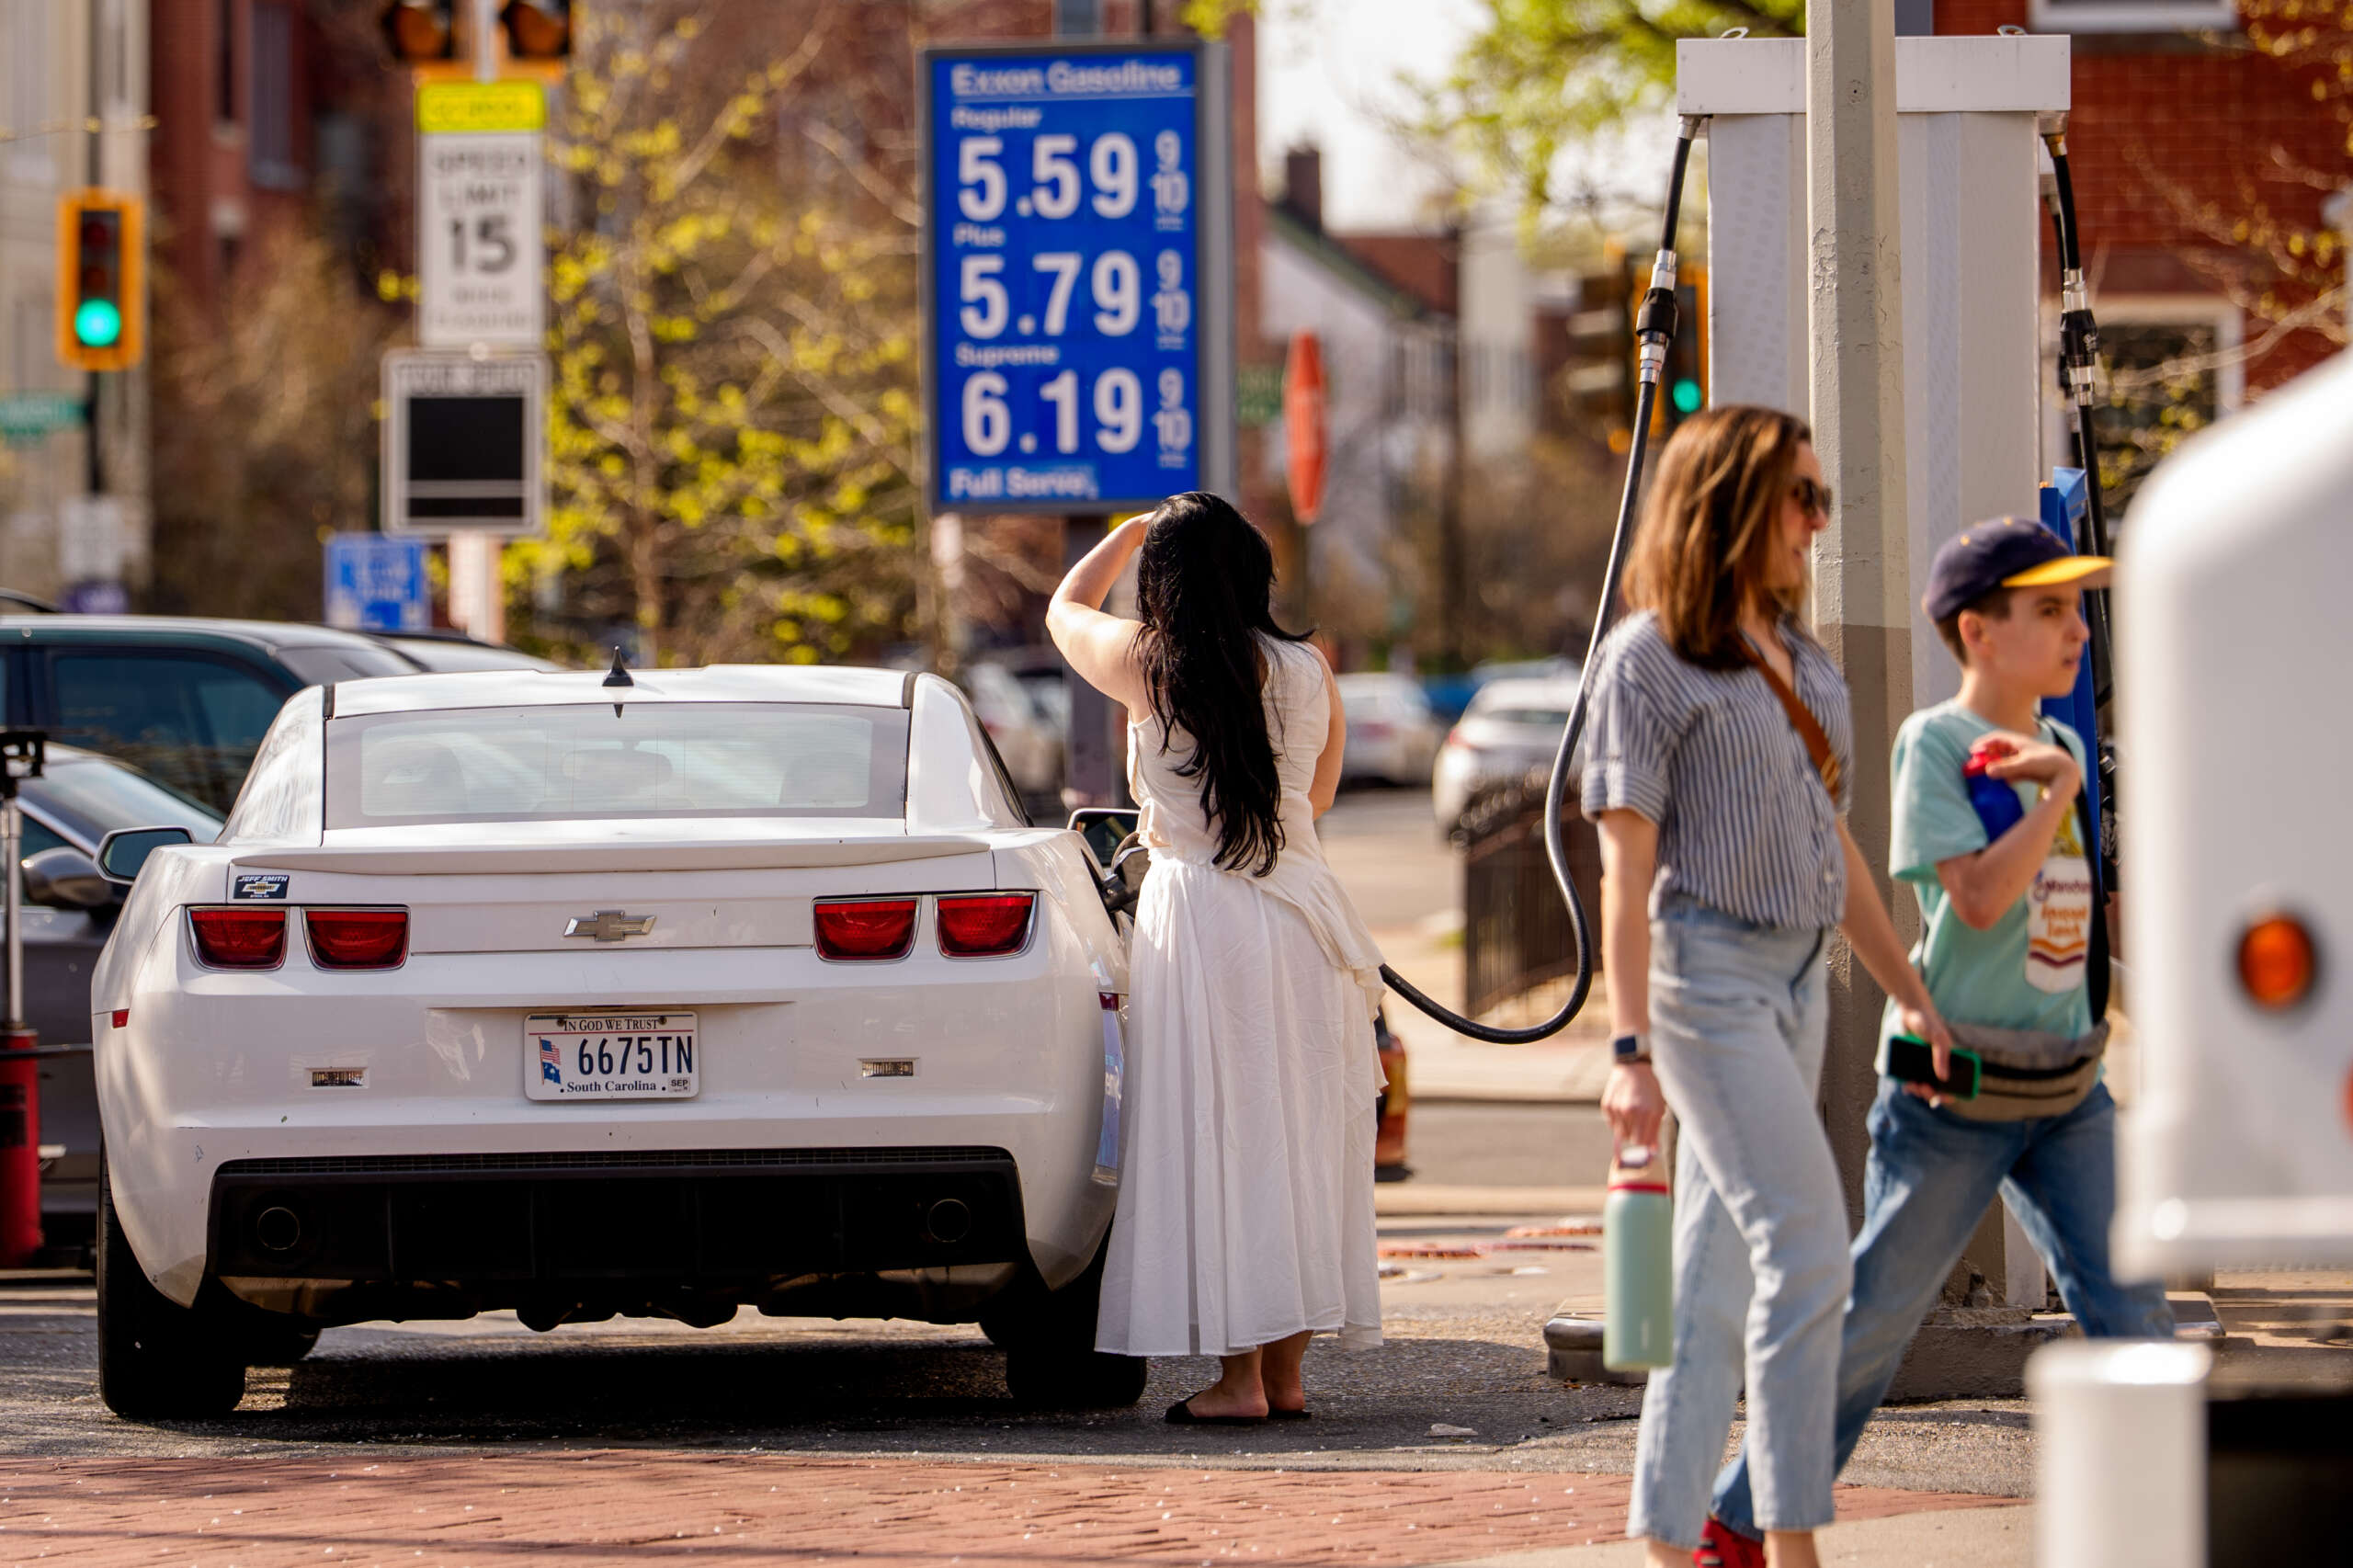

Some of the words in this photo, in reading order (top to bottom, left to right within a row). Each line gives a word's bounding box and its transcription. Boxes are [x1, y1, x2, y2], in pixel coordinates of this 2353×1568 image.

[951, 63, 1045, 96] Exxon
[1048, 61, 1182, 93] Gasoline
[951, 106, 1042, 133] Regular
[958, 132, 1138, 221] 5.59
[450, 215, 518, 273] 15
[953, 223, 1006, 246] Plus
[960, 250, 1141, 339] 5.79
[955, 342, 1060, 369] Supreme
[961, 367, 1142, 457] 6.19
[949, 467, 1003, 498] Full
[563, 1020, 576, 1031] IN
[579, 1019, 602, 1031] GOD
[605, 1019, 622, 1030] WE
[625, 1018, 659, 1030] TRUST
[578, 1036, 693, 1075] 6675TN
[566, 1081, 601, 1093] South
[605, 1080, 656, 1092] Carolina
